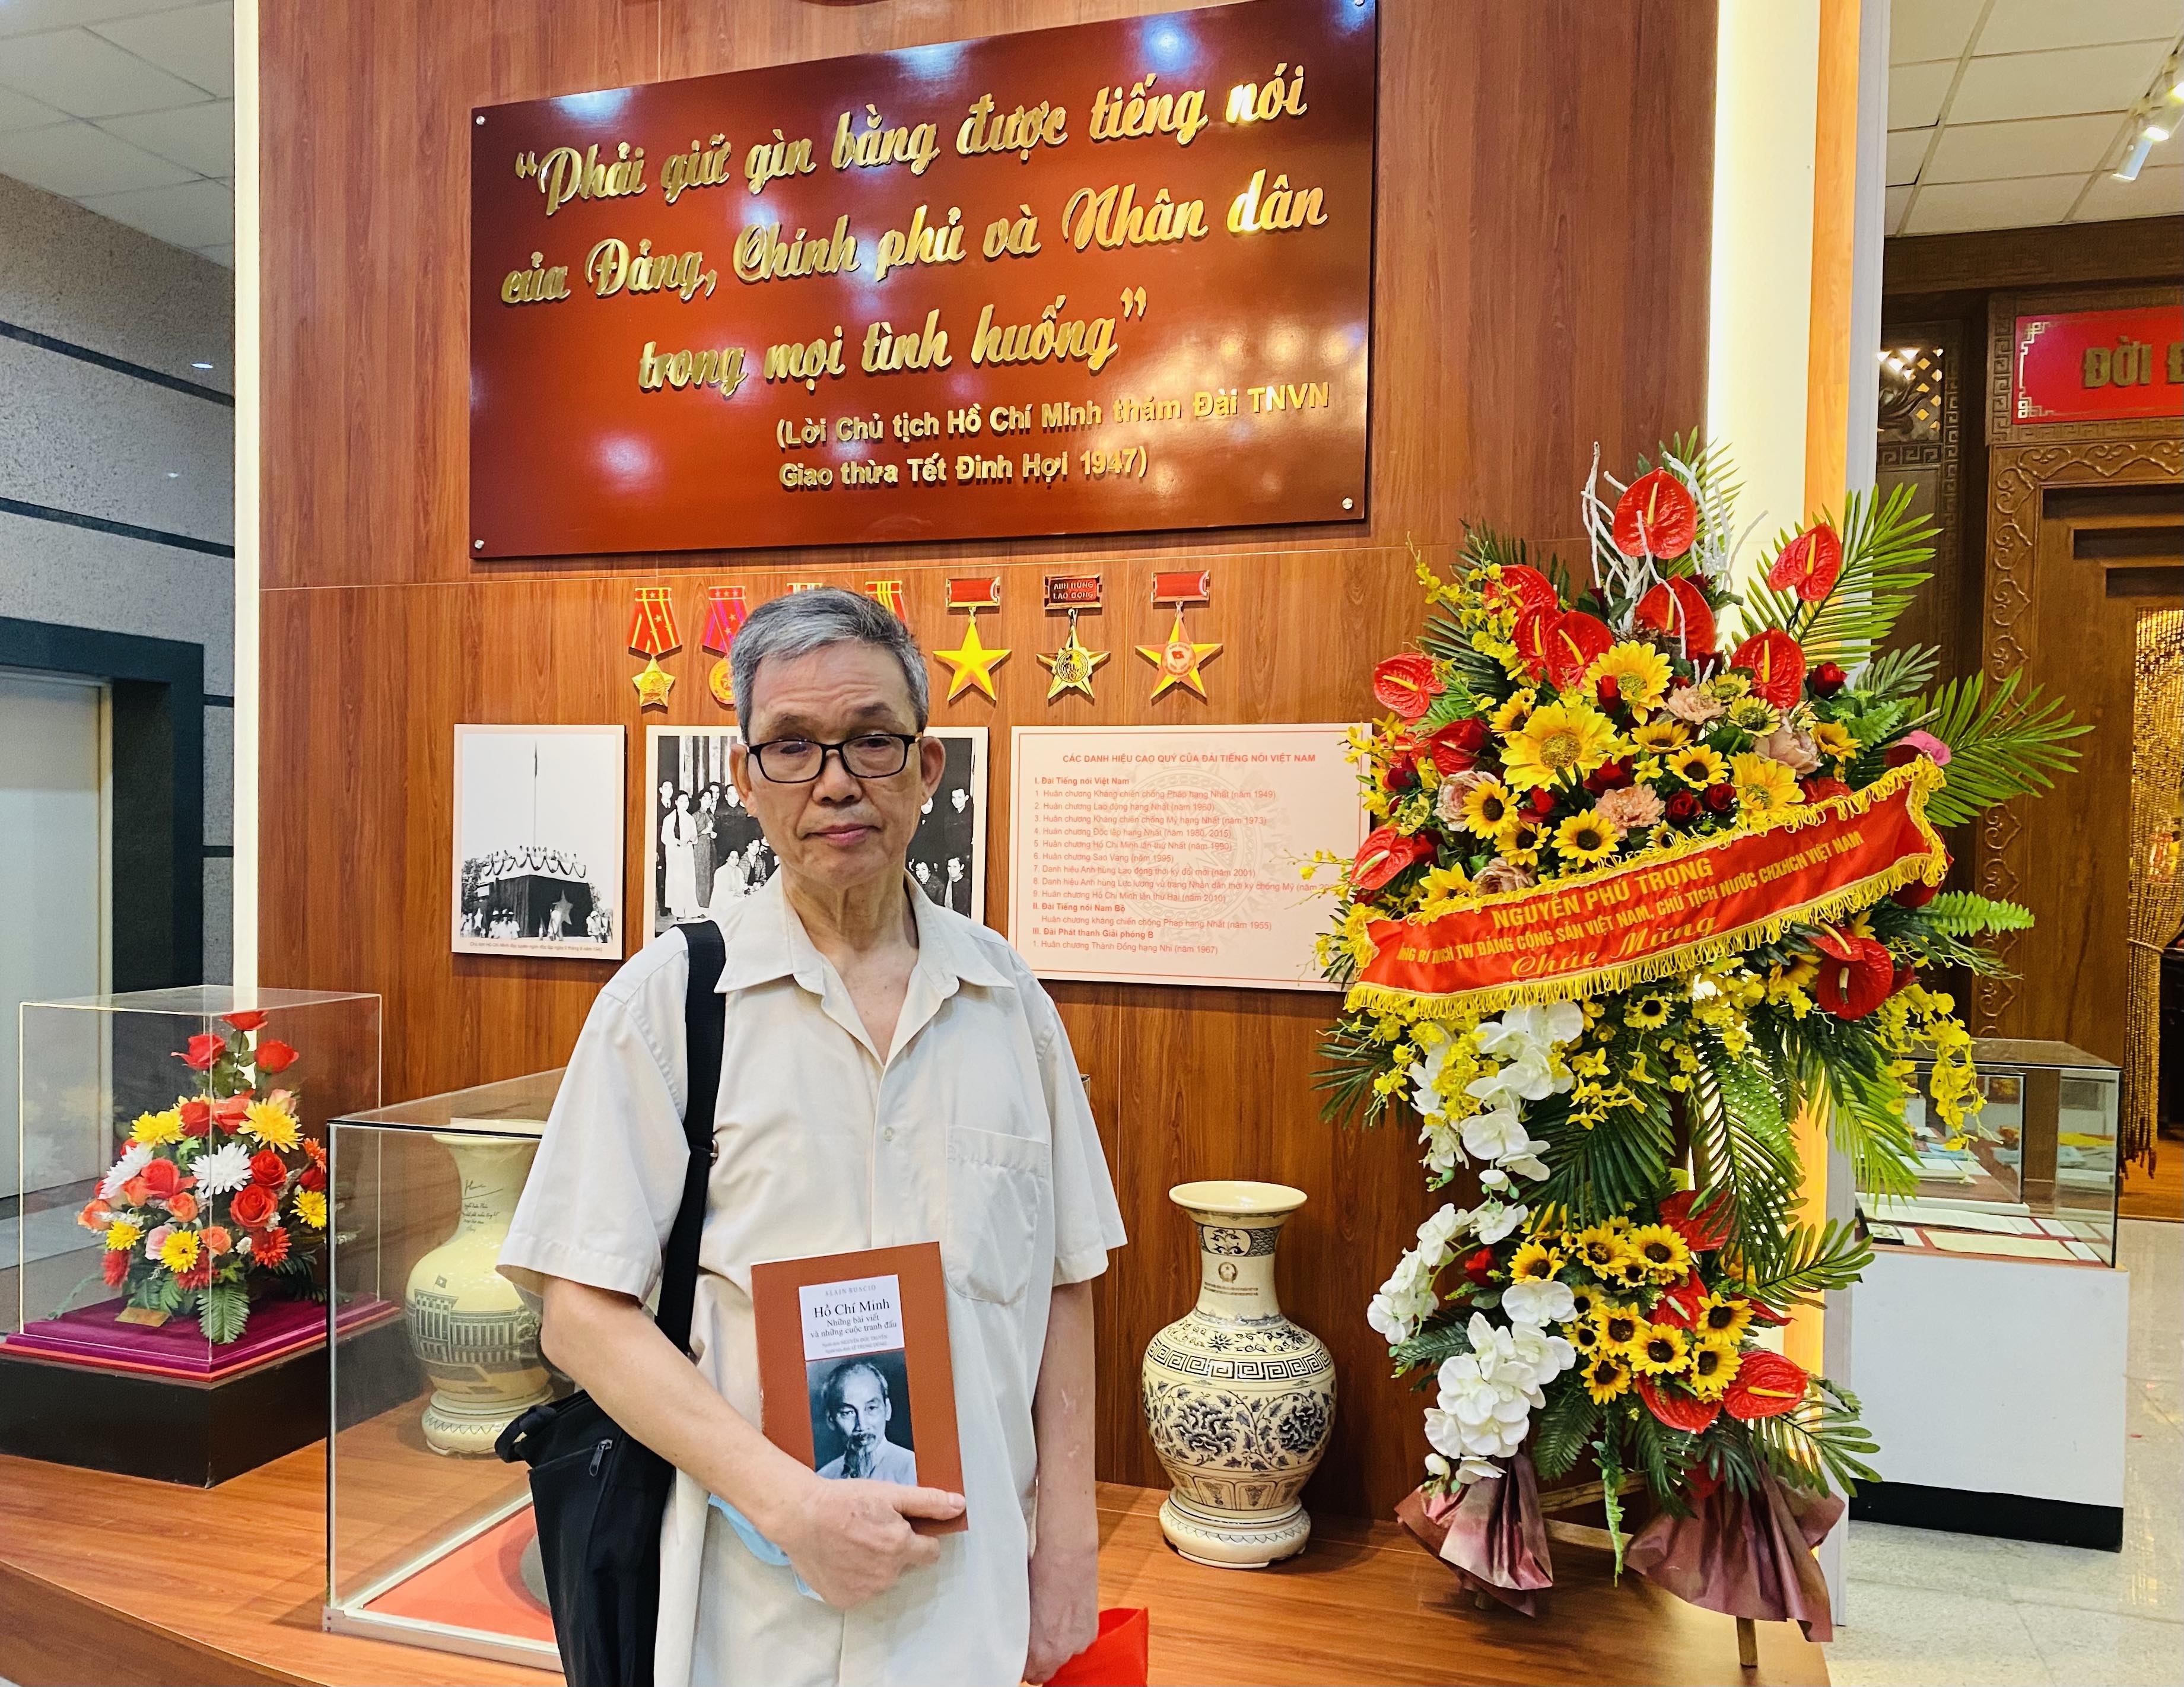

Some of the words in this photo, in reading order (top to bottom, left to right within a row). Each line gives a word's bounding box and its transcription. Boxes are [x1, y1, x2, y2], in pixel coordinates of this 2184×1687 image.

[660, 133, 730, 204] giữ
[745, 129, 815, 194] gìn
[831, 104, 940, 174] bằng
[955, 93, 1068, 162] được
[1089, 73, 1208, 144] tiếng
[1225, 62, 1307, 123] nói
[501, 252, 571, 304] của
[585, 238, 717, 301] Đảng,
[733, 214, 860, 283] Chính
[877, 204, 966, 281] phủ
[983, 204, 1041, 258] và
[1062, 183, 1208, 250] Nhân
[1226, 169, 1327, 236] dân
[639, 341, 748, 396] trong
[763, 325, 845, 392] mọi
[861, 309, 952, 373] tình
[2084, 335, 2152, 387] ĐỜI
[776, 417, 827, 449] (Lời
[835, 412, 883, 441] Chủ
[892, 411, 940, 443] tịch
[948, 402, 982, 434] Hồ
[990, 404, 1033, 436] Chí
[1041, 400, 1102, 428] Minh
[1193, 388, 1238, 417] Đài
[1247, 382, 1329, 414] TNVN
[778, 462, 833, 487] Giao
[840, 459, 898, 485] thừa
[907, 451, 947, 482] Tết
[955, 454, 1012, 482] Đinh
[1023, 451, 1069, 482] Hợi
[1080, 446, 1147, 477] 1947)
[1063, 753, 1081, 763] CÁC
[1158, 752, 1177, 763] QUÝ
[1251, 752, 1267, 762] NÓI
[1271, 752, 1290, 764] VIỆT
[1095, 777, 1109, 786] Việt
[1455, 943, 1474, 960] TW
[1476, 935, 1514, 956] ĐẢNG
[1515, 930, 1553, 952] CỘNG
[1556, 921, 1585, 943] SẢN
[1584, 916, 1614, 935] VIỆT
[1616, 905, 1654, 929] NAM,
[1657, 889, 1684, 917] CHỦ
[1687, 886, 1718, 908] TỊCH
[1720, 870, 1758, 898] NƯỚC
[1759, 856, 1807, 882] CHXHCN
[1805, 844, 1833, 865] VIỆT
[1835, 831, 1864, 854] NAM
[1492, 895, 1581, 928] NGUYỄN
[1585, 879, 1630, 910] PHÚ
[1636, 857, 1713, 891] TRỌNG
[1511, 950, 1598, 977] Chúc
[1608, 916, 1719, 958] Mừng
[814, 1304, 831, 1318] Hồ
[835, 1302, 856, 1315] Chí
[860, 1298, 889, 1313] Minh
[821, 1328, 843, 1337] những
[845, 1326, 861, 1334] cuộc
[884, 1319, 897, 1328] đấu
[827, 1319, 851, 1327] Những
[867, 1313, 879, 1321] viết
